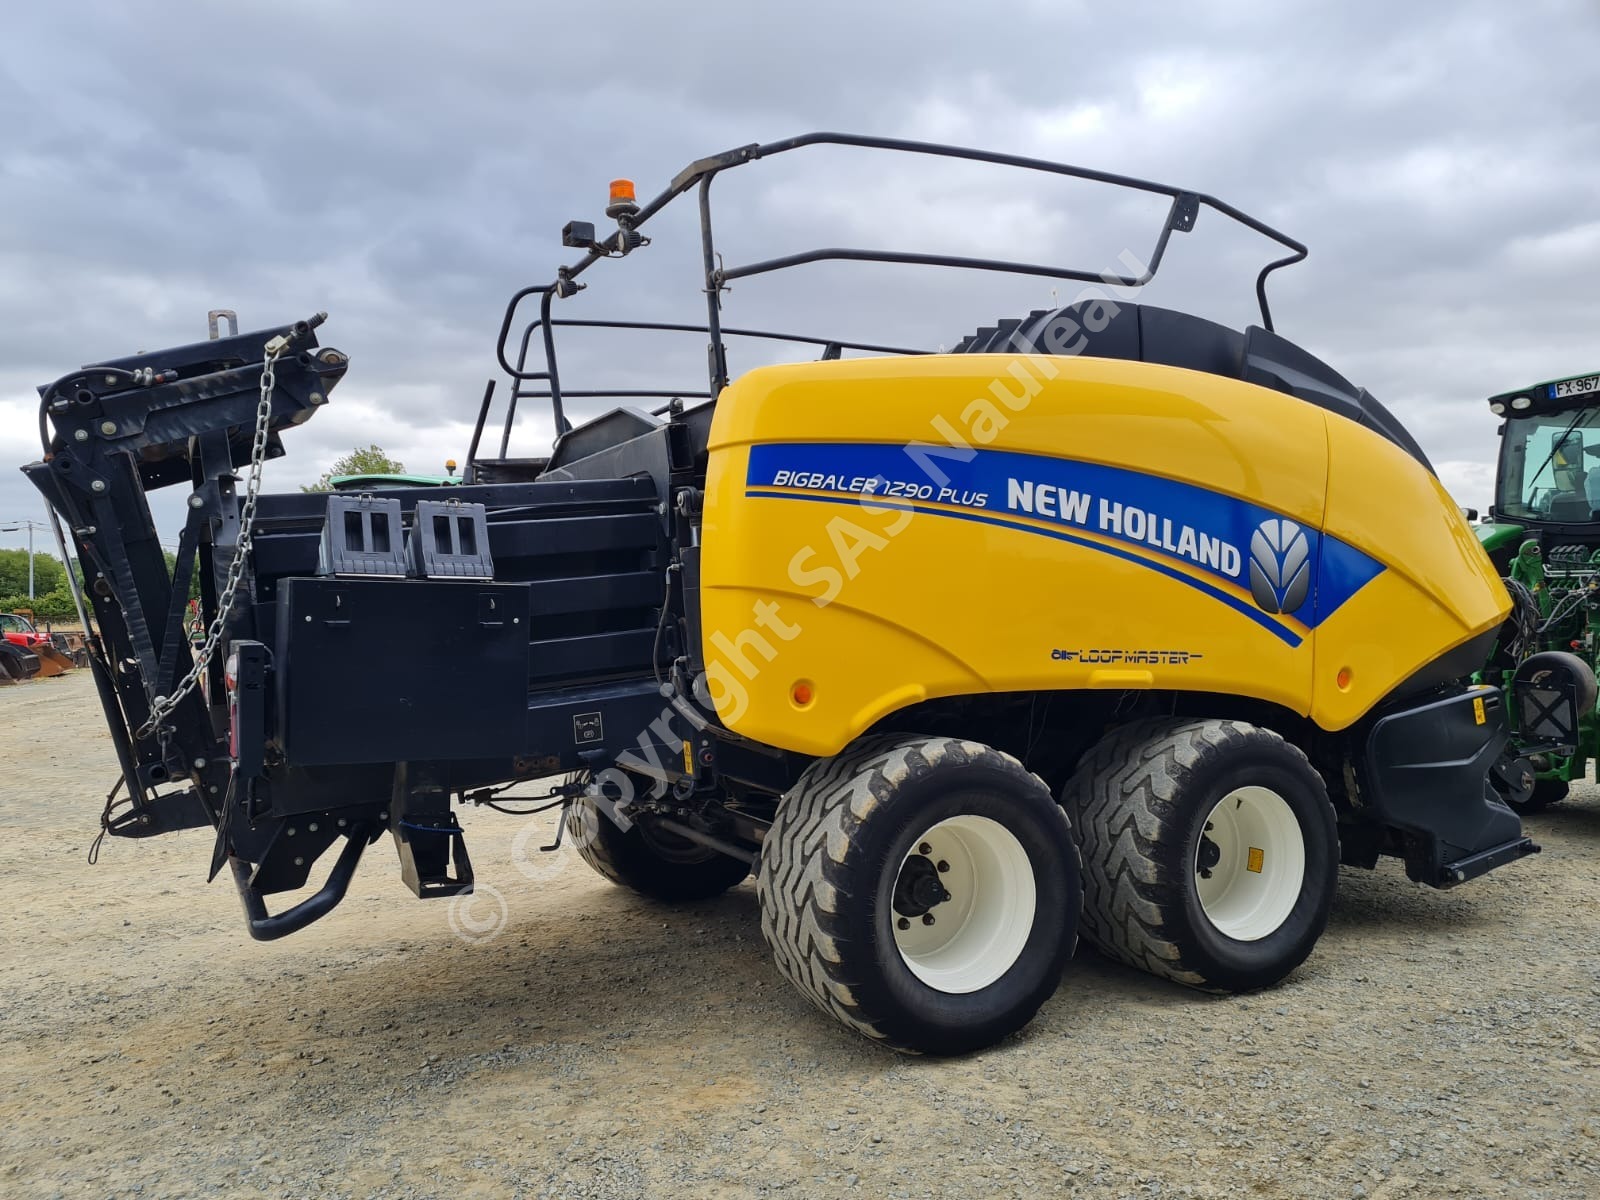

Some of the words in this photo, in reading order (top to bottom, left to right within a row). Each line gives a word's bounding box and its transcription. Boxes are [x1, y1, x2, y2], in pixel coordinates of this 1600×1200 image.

[772, 470, 878, 494] BIGBALER
[883, 480, 933, 499] 1290
[937, 486, 989, 507] PLUS
[1007, 477, 1091, 525] NEW
[1099, 497, 1242, 578] HOLLAND
